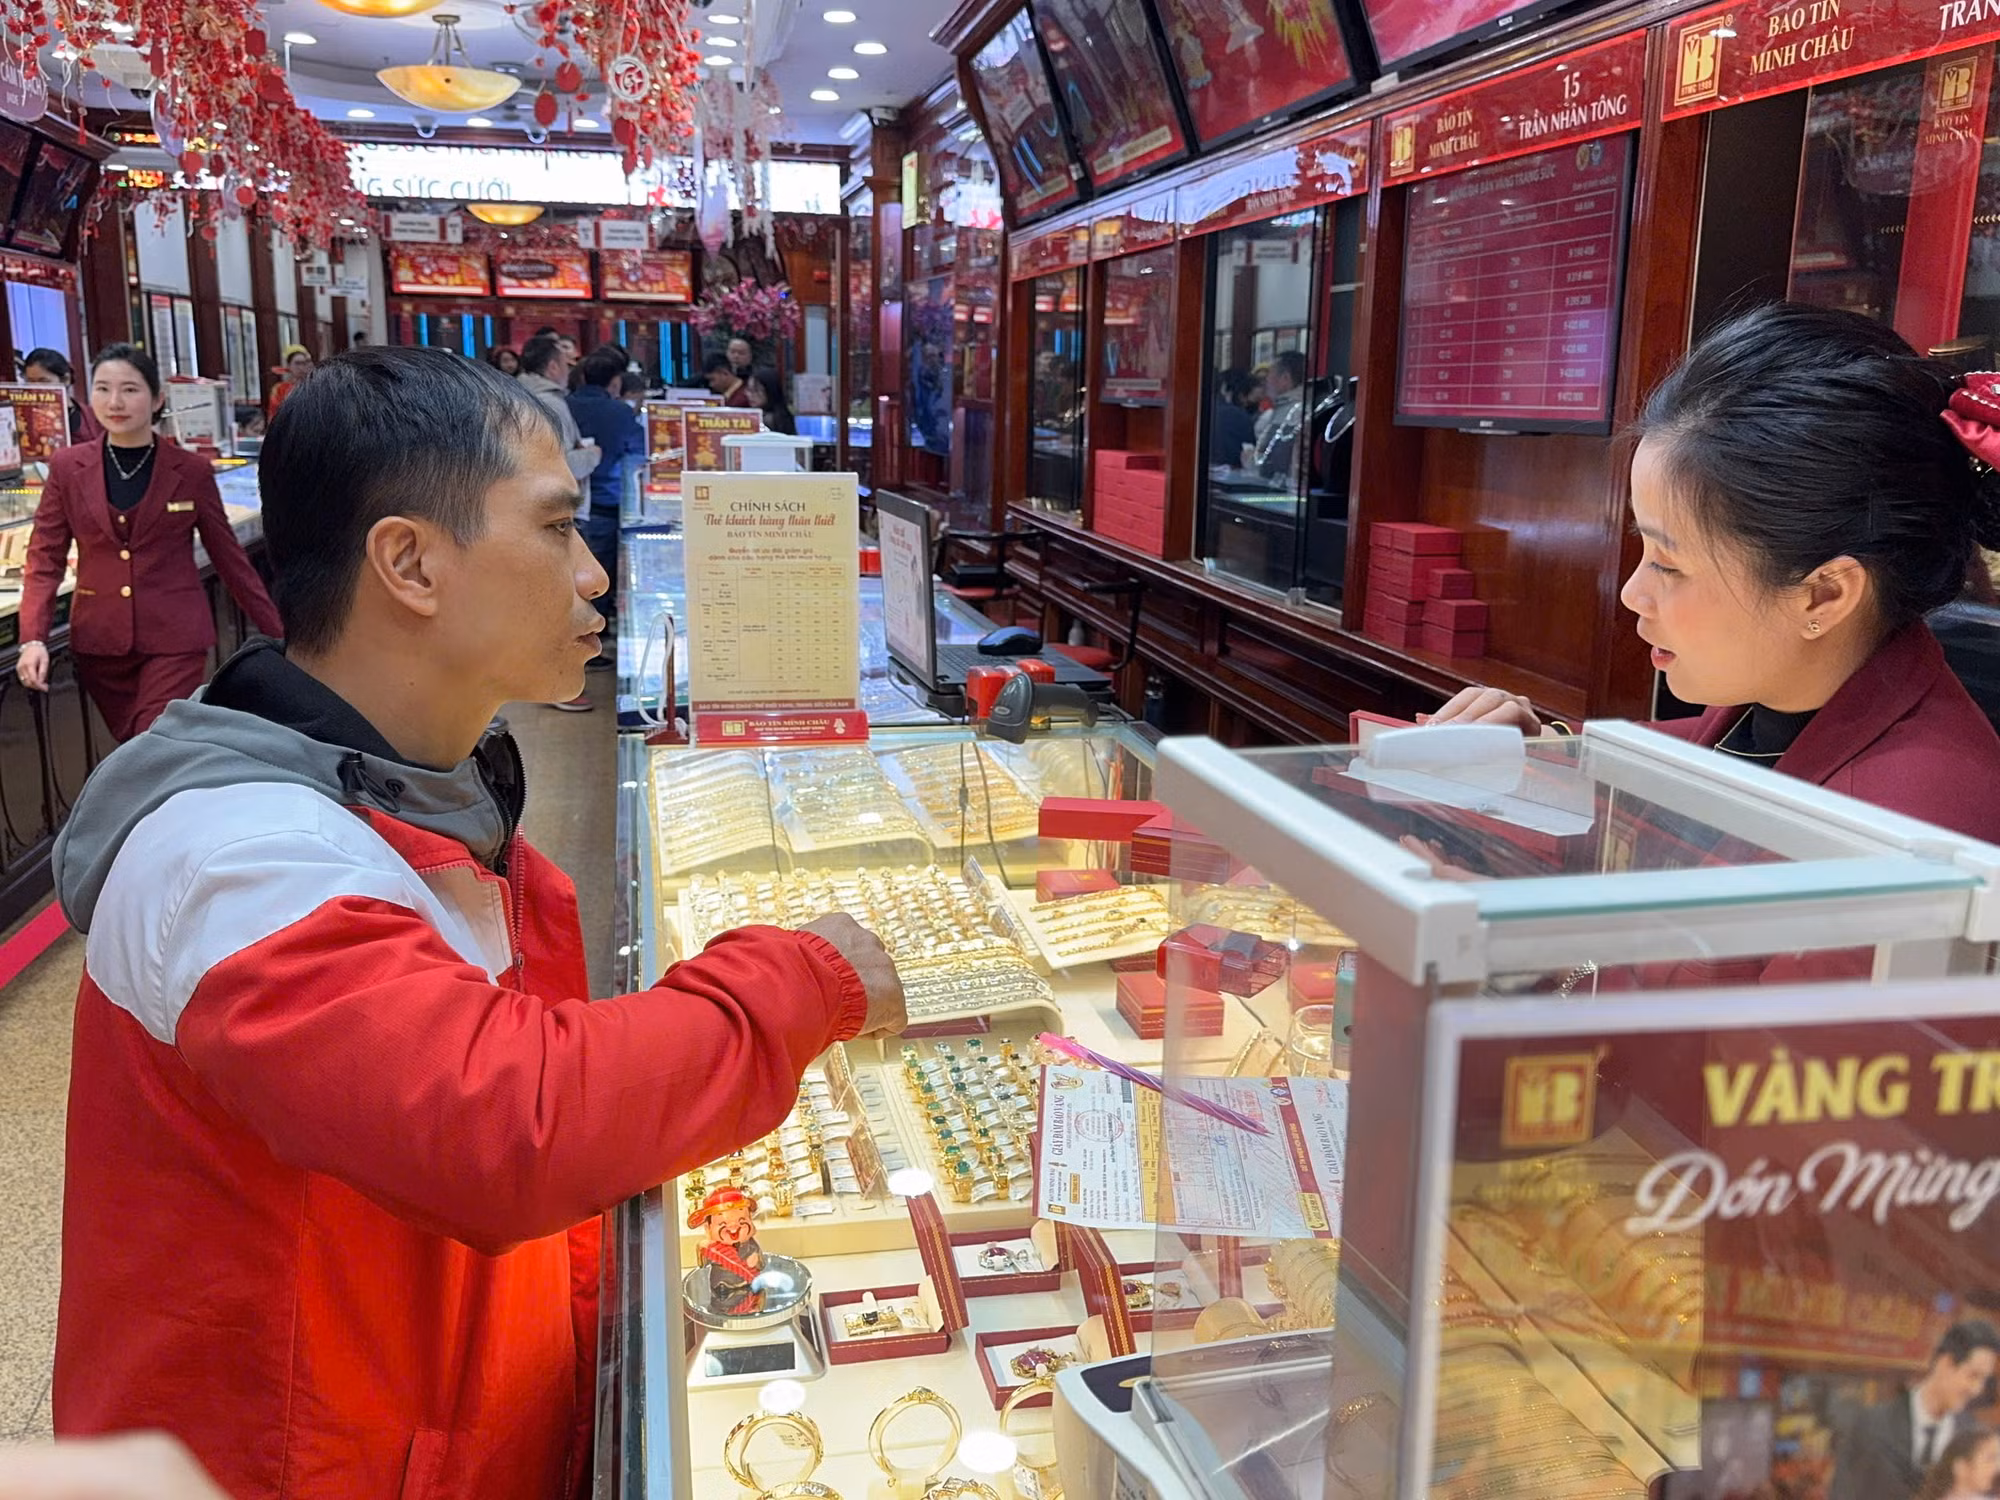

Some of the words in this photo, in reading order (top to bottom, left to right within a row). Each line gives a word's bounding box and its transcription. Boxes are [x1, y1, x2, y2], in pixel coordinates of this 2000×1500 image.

[1750, 43, 1798, 76] MINH
[1800, 26, 1855, 62] CHÂU
[1563, 71, 1581, 99] 15
[1456, 105, 1474, 129] TÍN
[1518, 107, 1549, 141] TRẦN
[1550, 102, 1590, 132] NHÂN
[1590, 94, 1628, 122] TÔNG
[1428, 137, 1452, 160] MINH
[1451, 128, 1481, 154] CHÂU
[730, 498, 772, 512] CHÍNH
[774, 499, 807, 512] SÁCH
[725, 513, 757, 526] khách
[759, 514, 785, 530] hàng
[1703, 1048, 1911, 1128] VÀNG
[1799, 1141, 2000, 1232] Mừng
